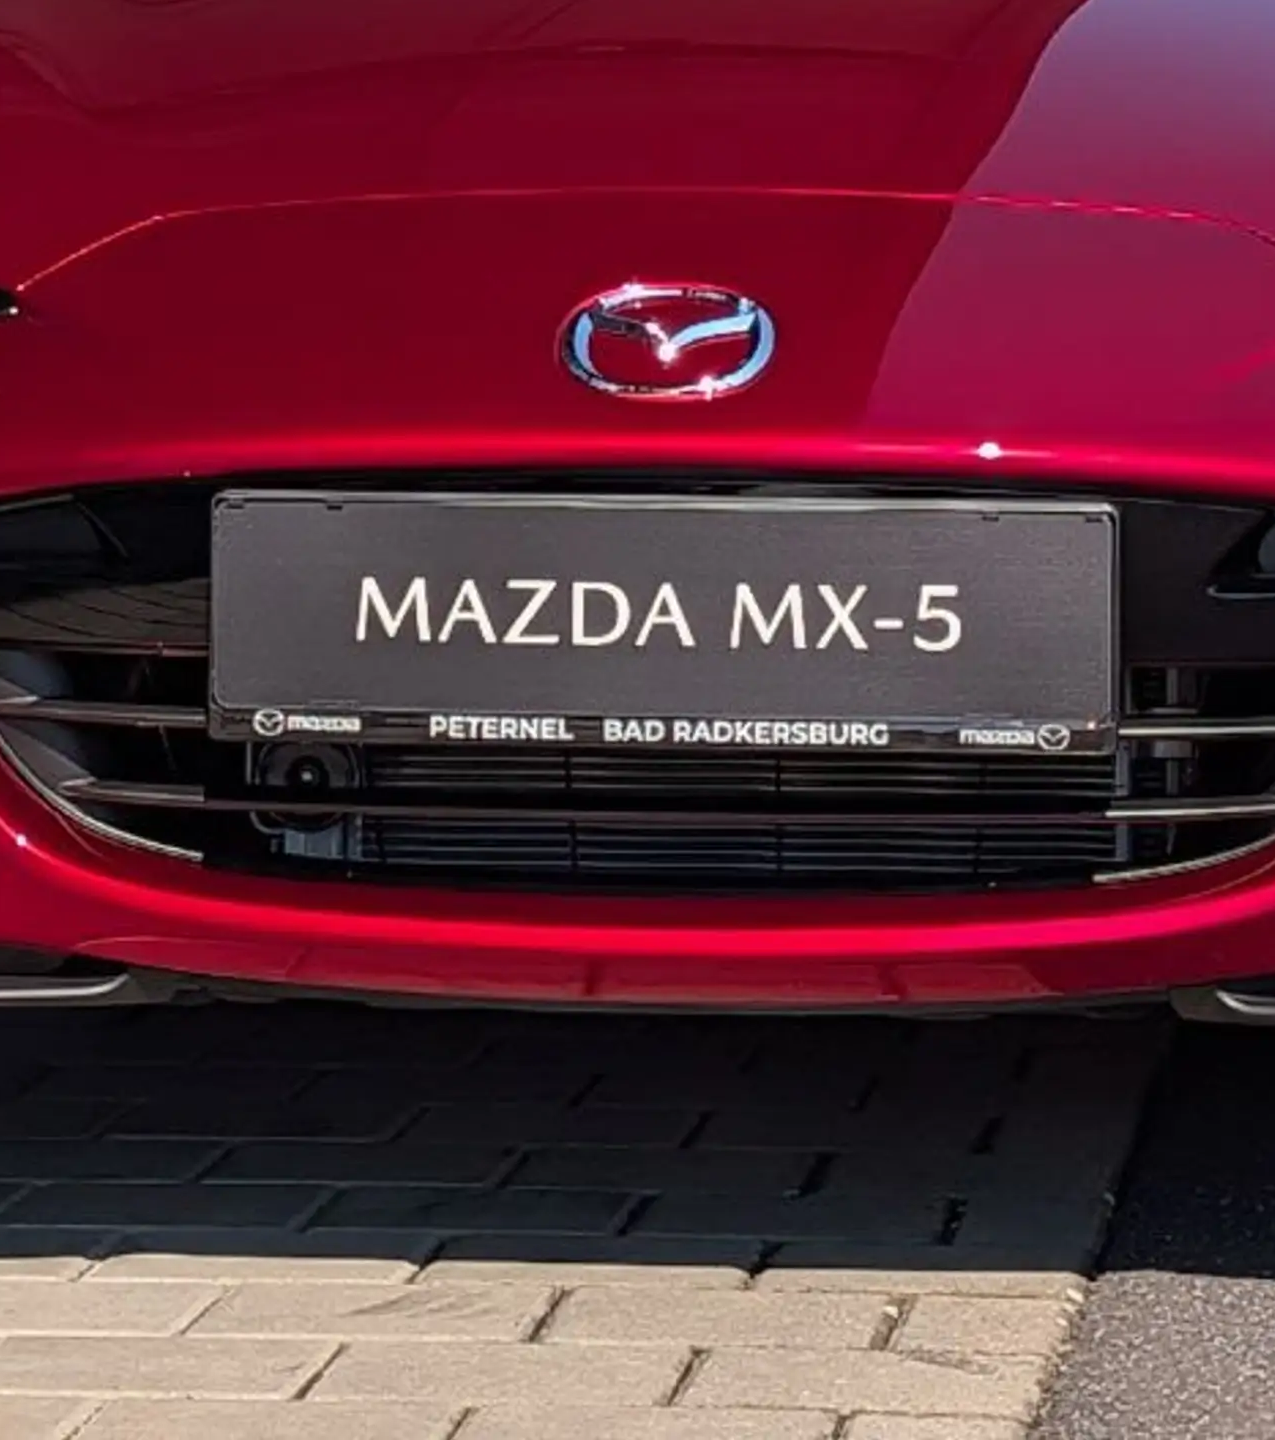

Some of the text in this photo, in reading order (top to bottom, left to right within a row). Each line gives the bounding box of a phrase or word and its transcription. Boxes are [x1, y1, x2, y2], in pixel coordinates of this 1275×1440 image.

[355, 575, 963, 652] MAZDA MX-5
[286, 714, 361, 733] mazda
[428, 714, 890, 746] PETERNEL BAD RADKERSBURG
[958, 727, 1036, 746] mazda
